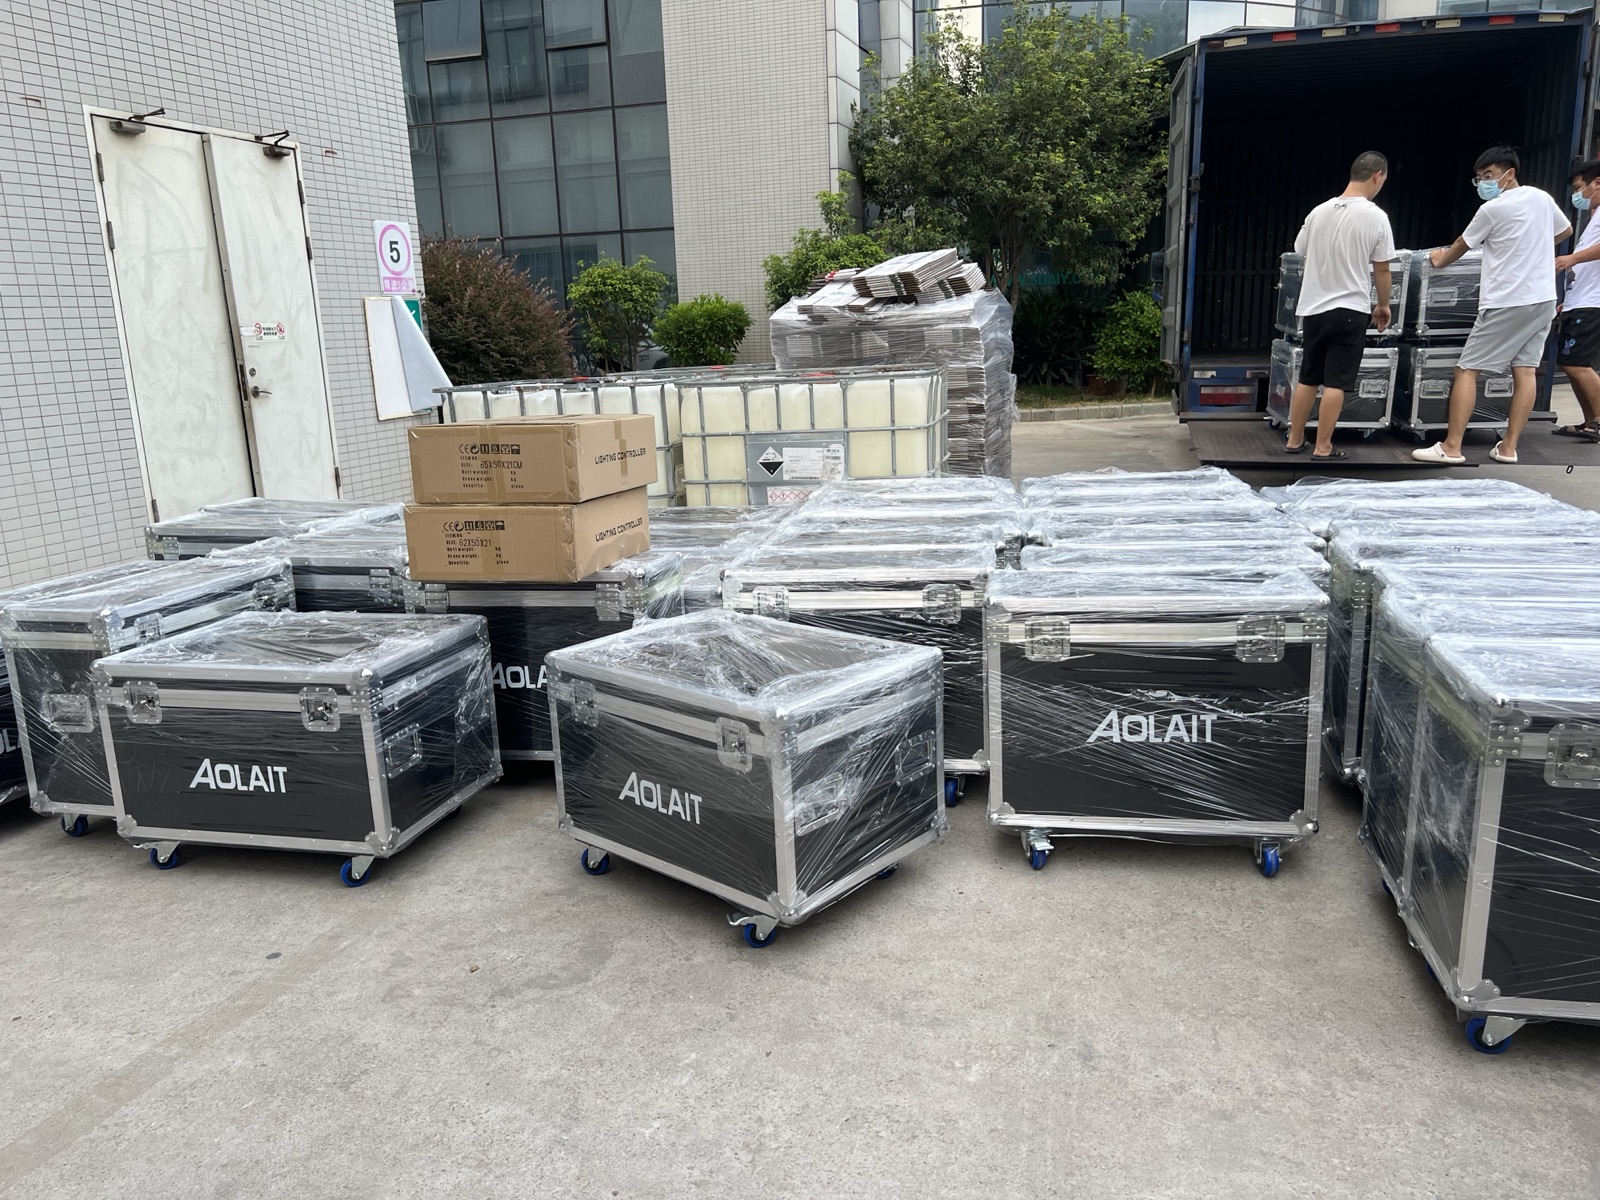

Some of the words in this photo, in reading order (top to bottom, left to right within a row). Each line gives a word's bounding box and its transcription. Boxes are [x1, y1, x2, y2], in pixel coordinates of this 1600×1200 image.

[389, 240, 401, 264] 5
[480, 460, 523, 470] 65X50X21CM
[595, 452, 617, 465] LIGHTING
[617, 447, 647, 461] CONTROLLER
[595, 527, 617, 542] LIGHTING
[617, 517, 643, 534] CONTROLLER
[459, 538, 492, 548] 62X50X21
[1086, 709, 1218, 743] AOLAIT
[189, 758, 288, 793] AOLAIT
[618, 771, 703, 825] AOLAIT
